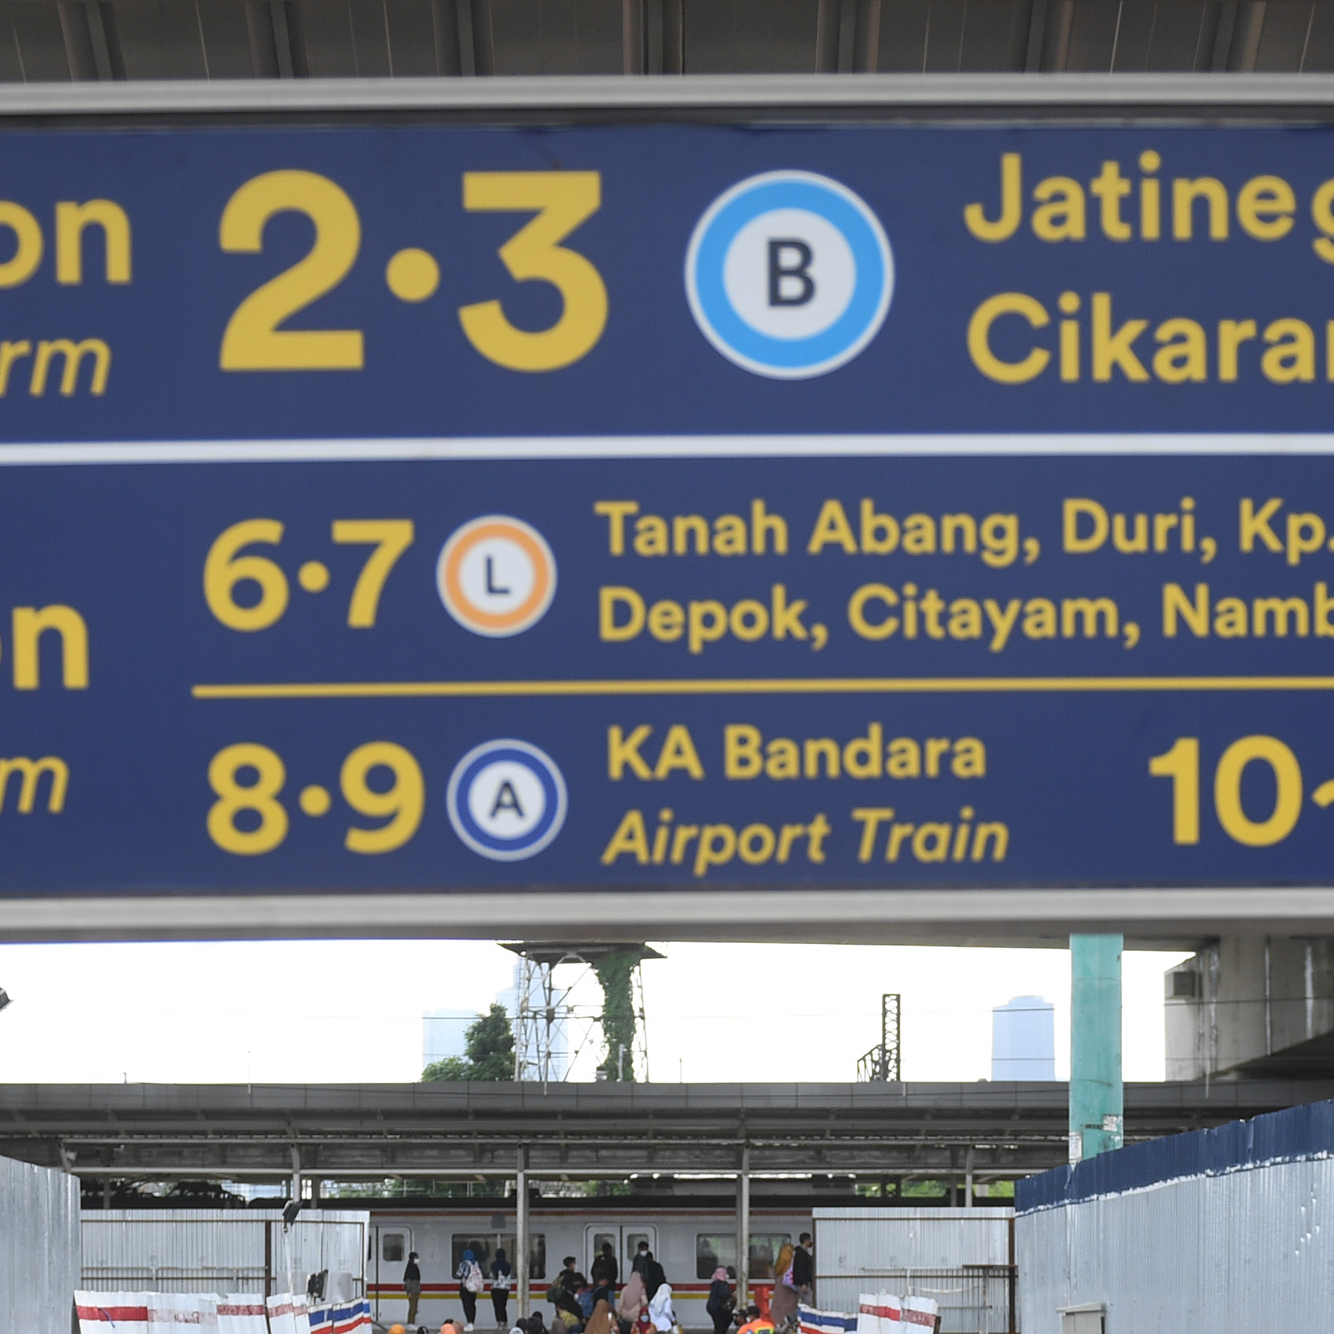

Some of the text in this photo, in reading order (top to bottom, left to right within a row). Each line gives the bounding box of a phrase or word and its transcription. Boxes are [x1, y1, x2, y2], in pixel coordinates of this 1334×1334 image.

[766, 237, 818, 310] B
[593, 498, 789, 557] Tanah
[807, 497, 1041, 569] Abang,
[1062, 495, 1218, 564] Duri,
[485, 556, 511, 595] L
[598, 582, 829, 655] Depok,
[847, 582, 1142, 653] Citayam,
[607, 721, 987, 781] KA Bandara
[490, 779, 525, 819] A
[601, 805, 1010, 878] Airport Train
